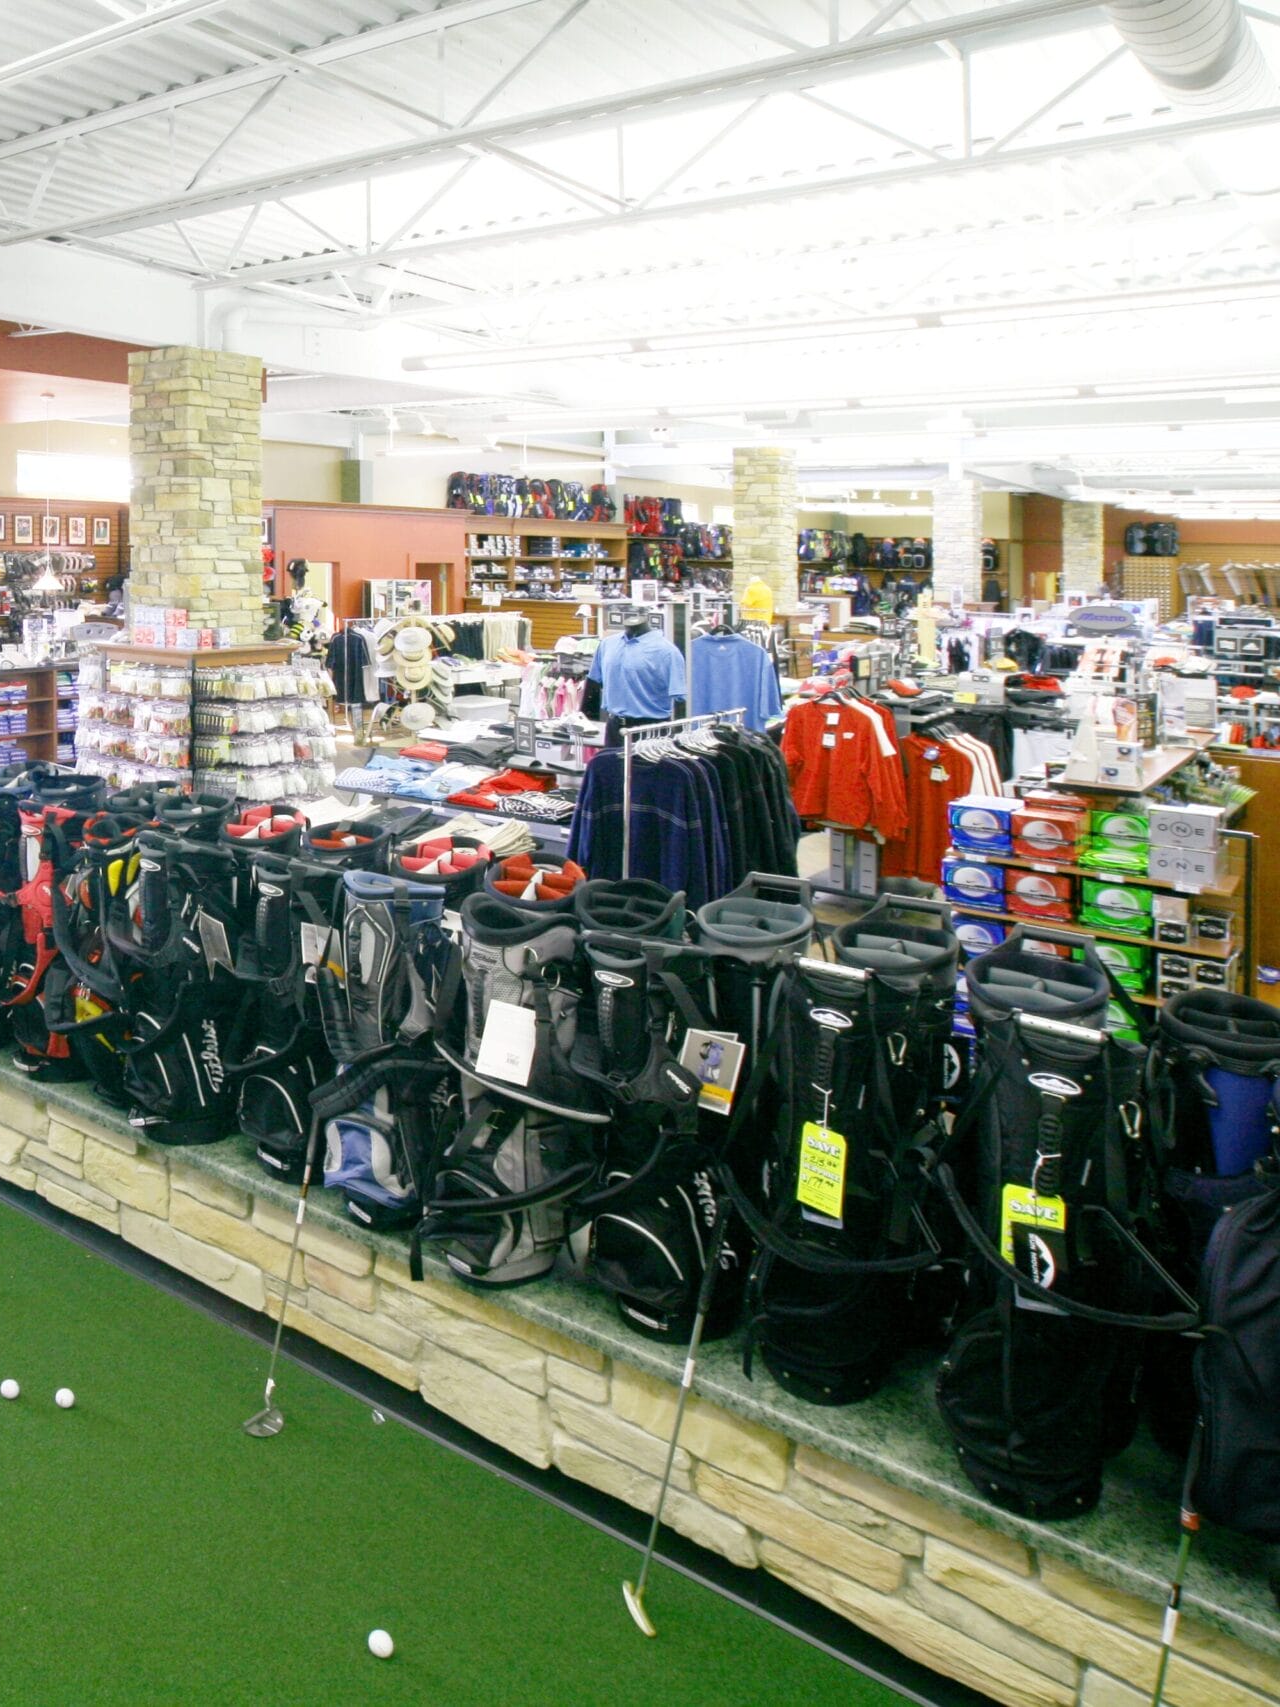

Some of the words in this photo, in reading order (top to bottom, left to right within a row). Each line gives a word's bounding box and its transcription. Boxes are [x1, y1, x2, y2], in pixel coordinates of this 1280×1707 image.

[201, 1019, 224, 1094] Titleist
[807, 1136, 842, 1159] SAVE
[1009, 1200, 1059, 1222] SAVE
